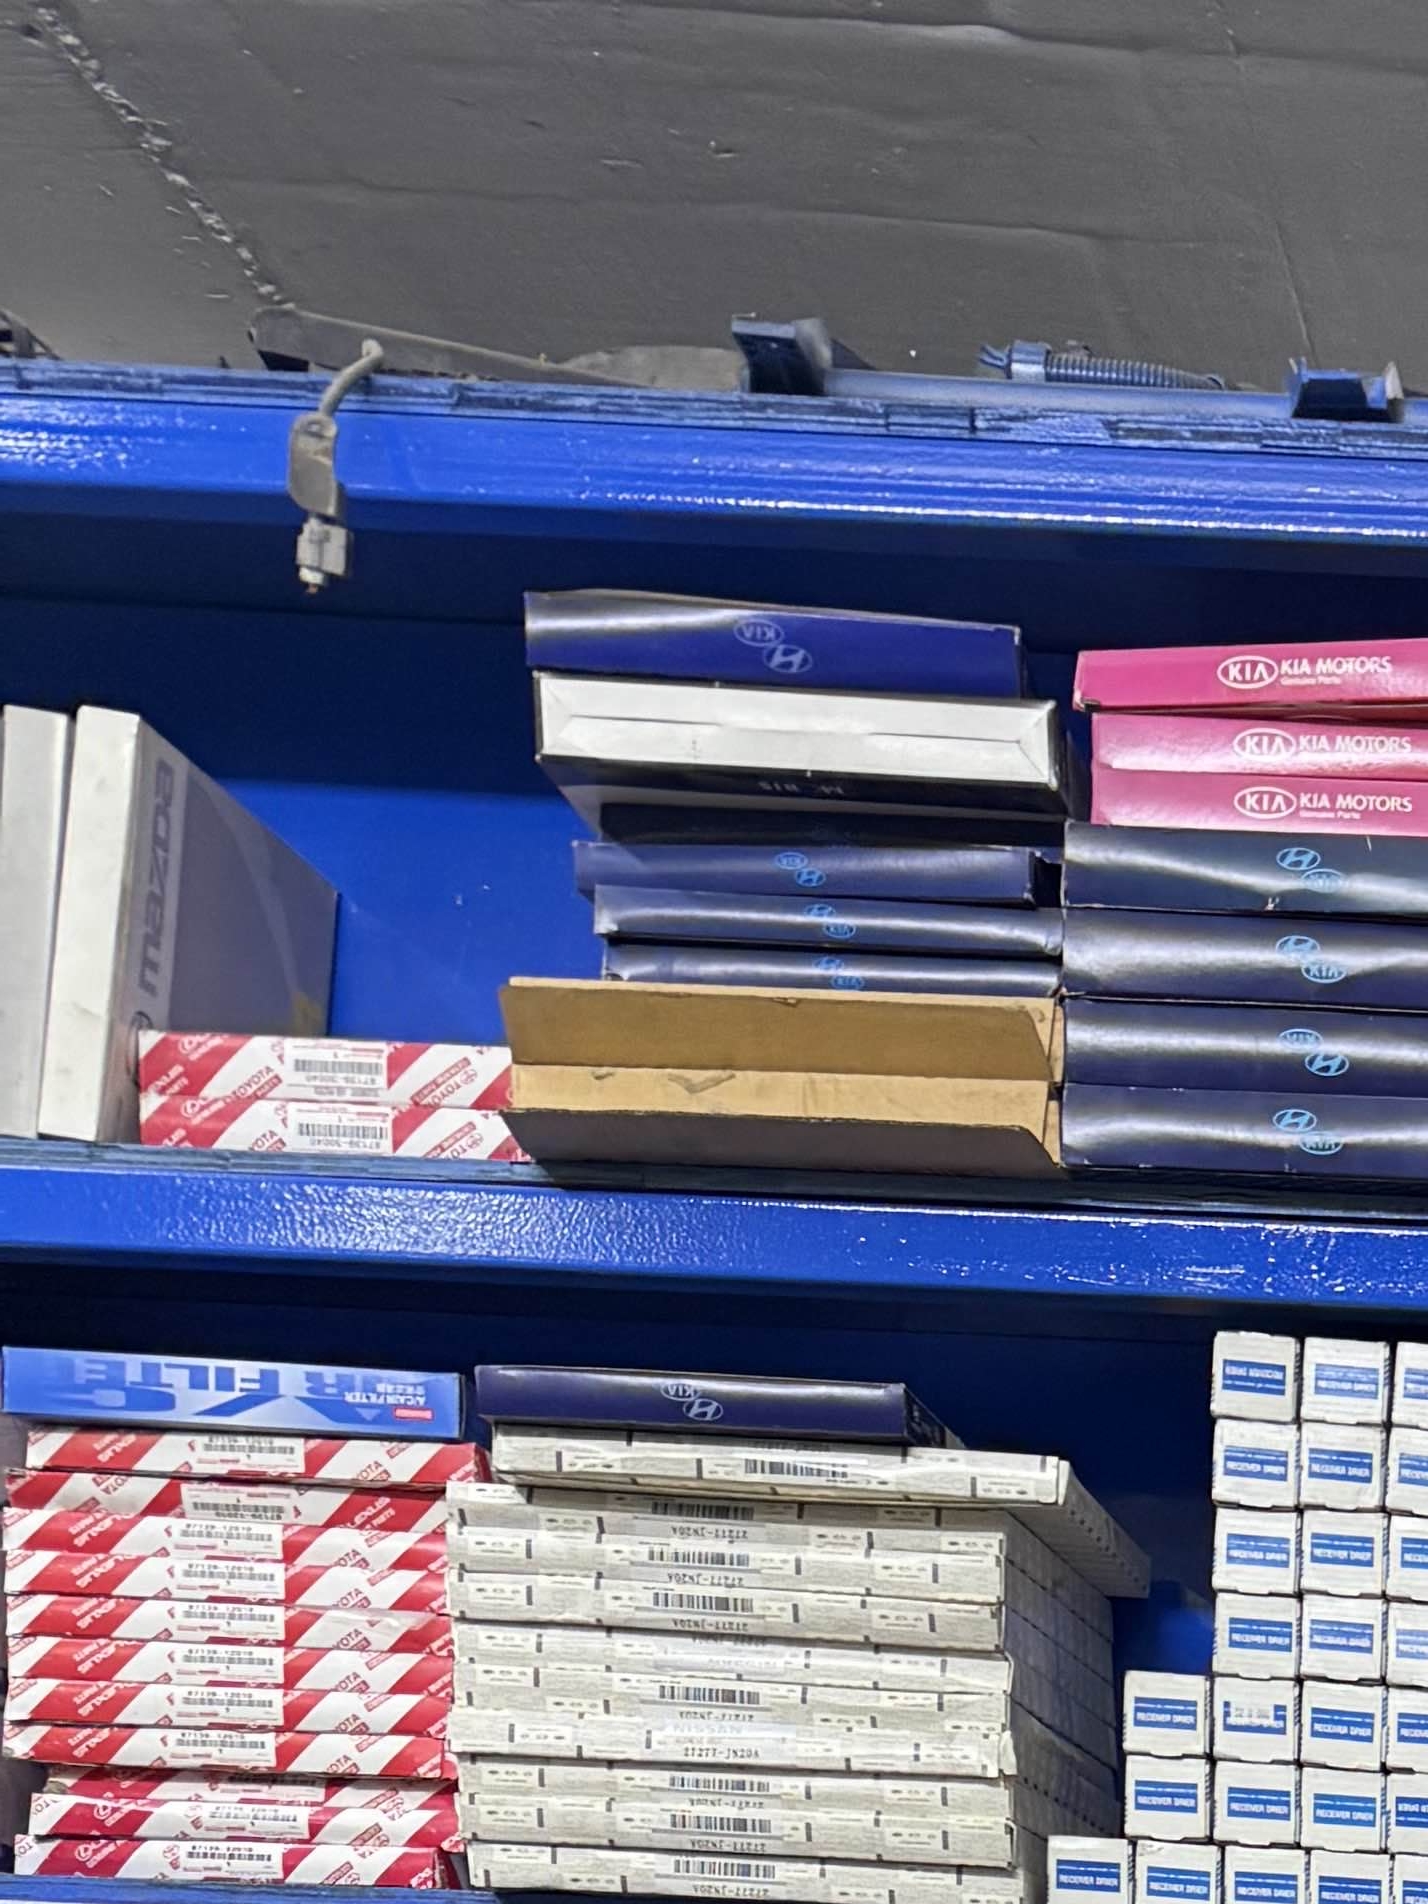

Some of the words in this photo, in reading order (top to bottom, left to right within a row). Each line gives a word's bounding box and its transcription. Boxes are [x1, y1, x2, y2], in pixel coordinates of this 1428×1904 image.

[1280, 658, 1311, 675] KIA
[1316, 655, 1392, 675] MOTORS
[1299, 735, 1330, 752] KIA
[1335, 735, 1412, 753] MOTORS
[1300, 793, 1331, 809] KIA
[1335, 794, 1413, 812] MOTORS
